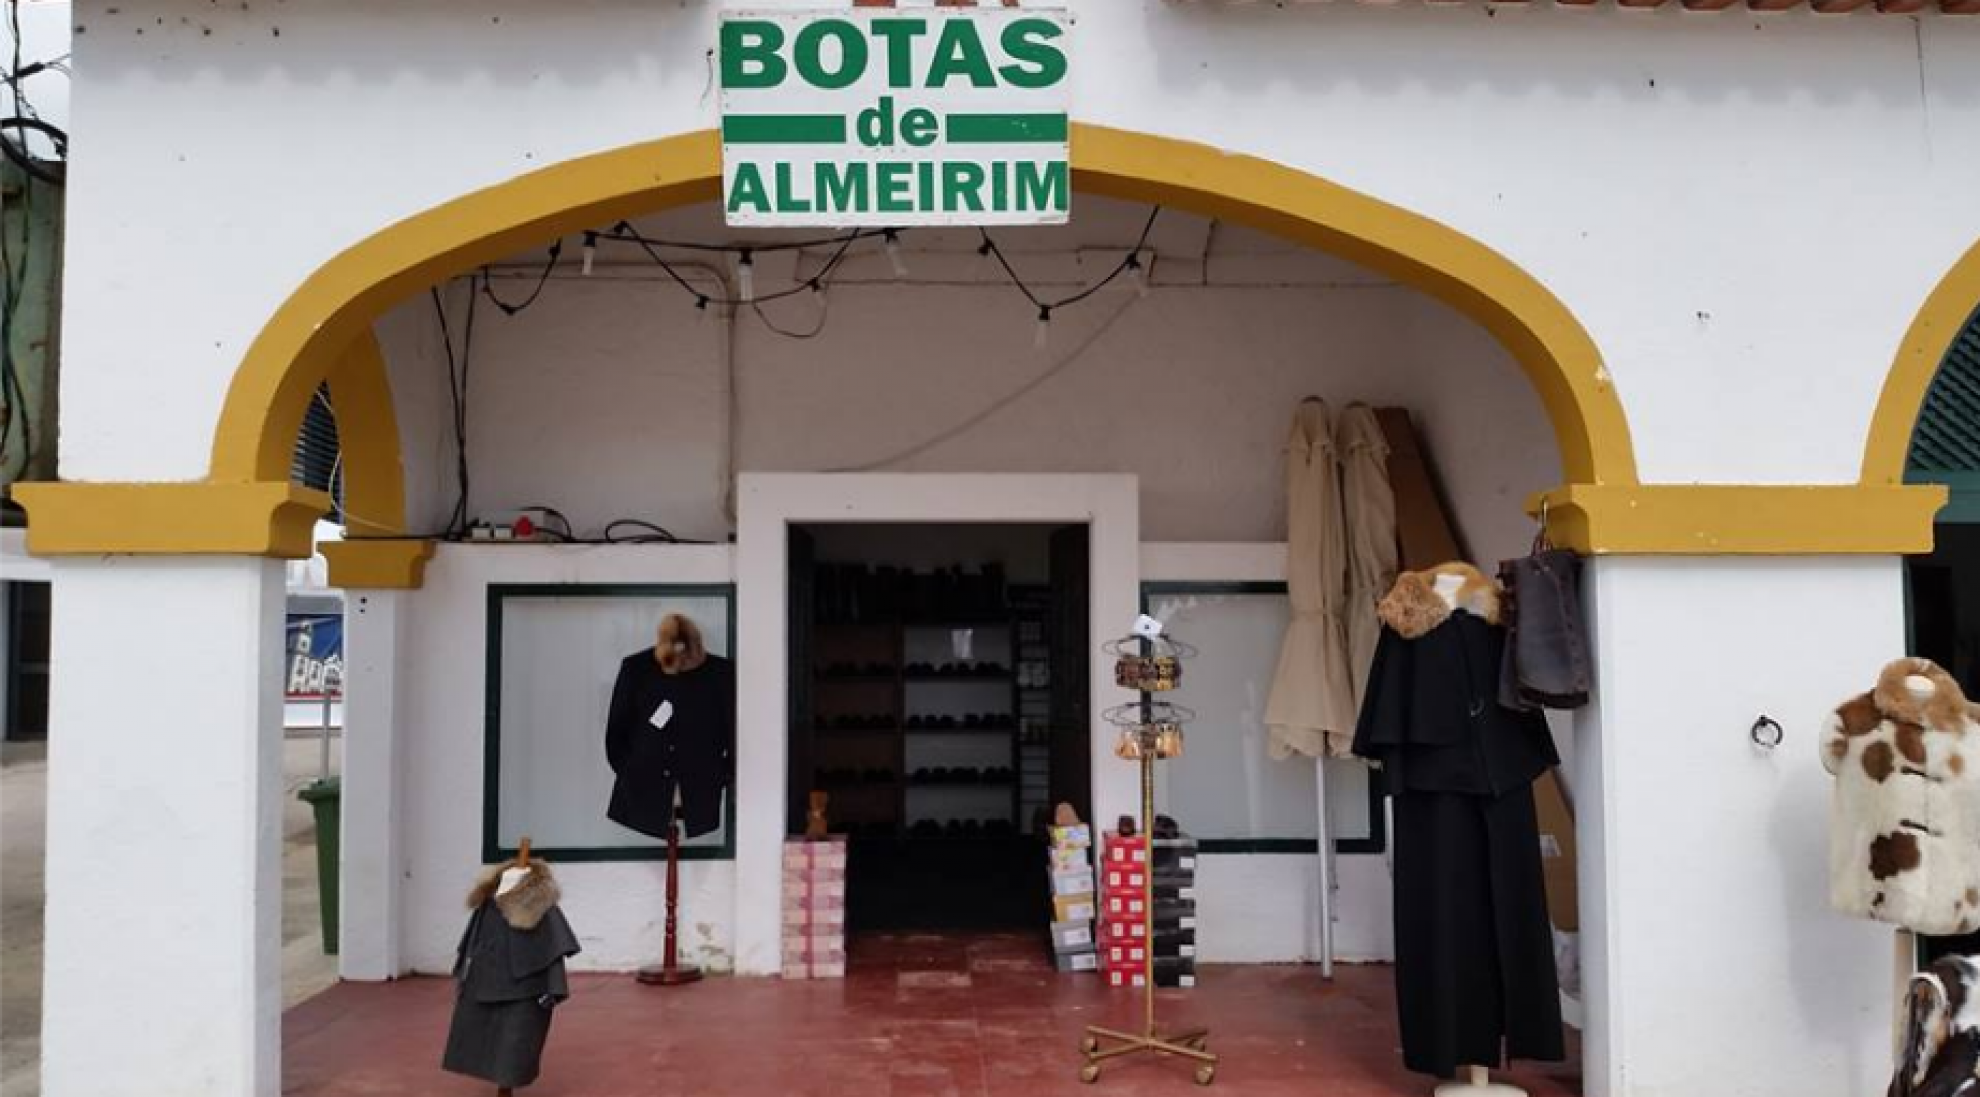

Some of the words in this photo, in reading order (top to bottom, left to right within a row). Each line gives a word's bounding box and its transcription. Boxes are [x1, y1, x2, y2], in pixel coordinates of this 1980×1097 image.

[720, 19, 1067, 89] BOTAS
[857, 97, 938, 146] de
[728, 161, 1068, 213] ALMEIRIM
